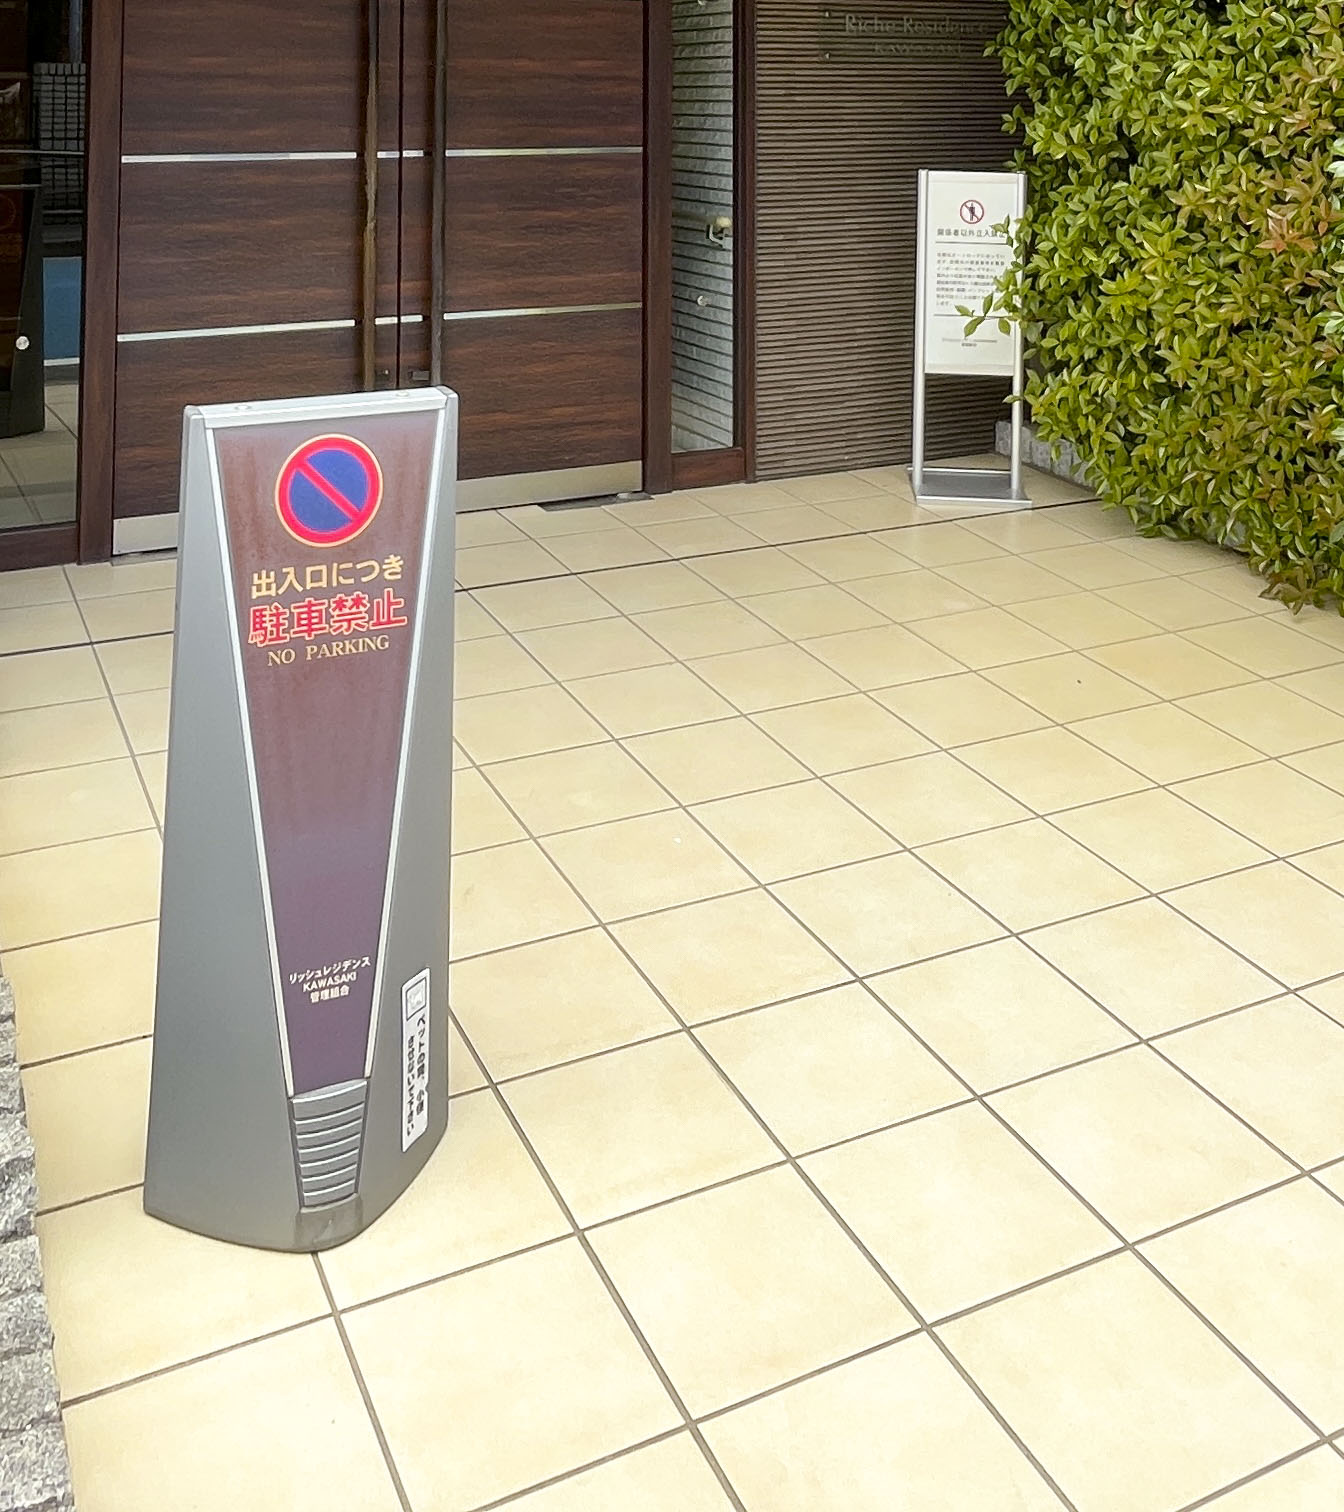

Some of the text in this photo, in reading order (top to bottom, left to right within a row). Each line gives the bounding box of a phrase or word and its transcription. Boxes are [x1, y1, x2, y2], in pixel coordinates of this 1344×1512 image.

[251, 554, 404, 599] 出入口につき
[248, 588, 408, 648] 駐車禁止
[267, 635, 390, 667] NO PARKING
[289, 956, 371, 985] リッシュレジデンス
[302, 971, 357, 993] KAWASAKI
[310, 984, 350, 1004] 管理組合
